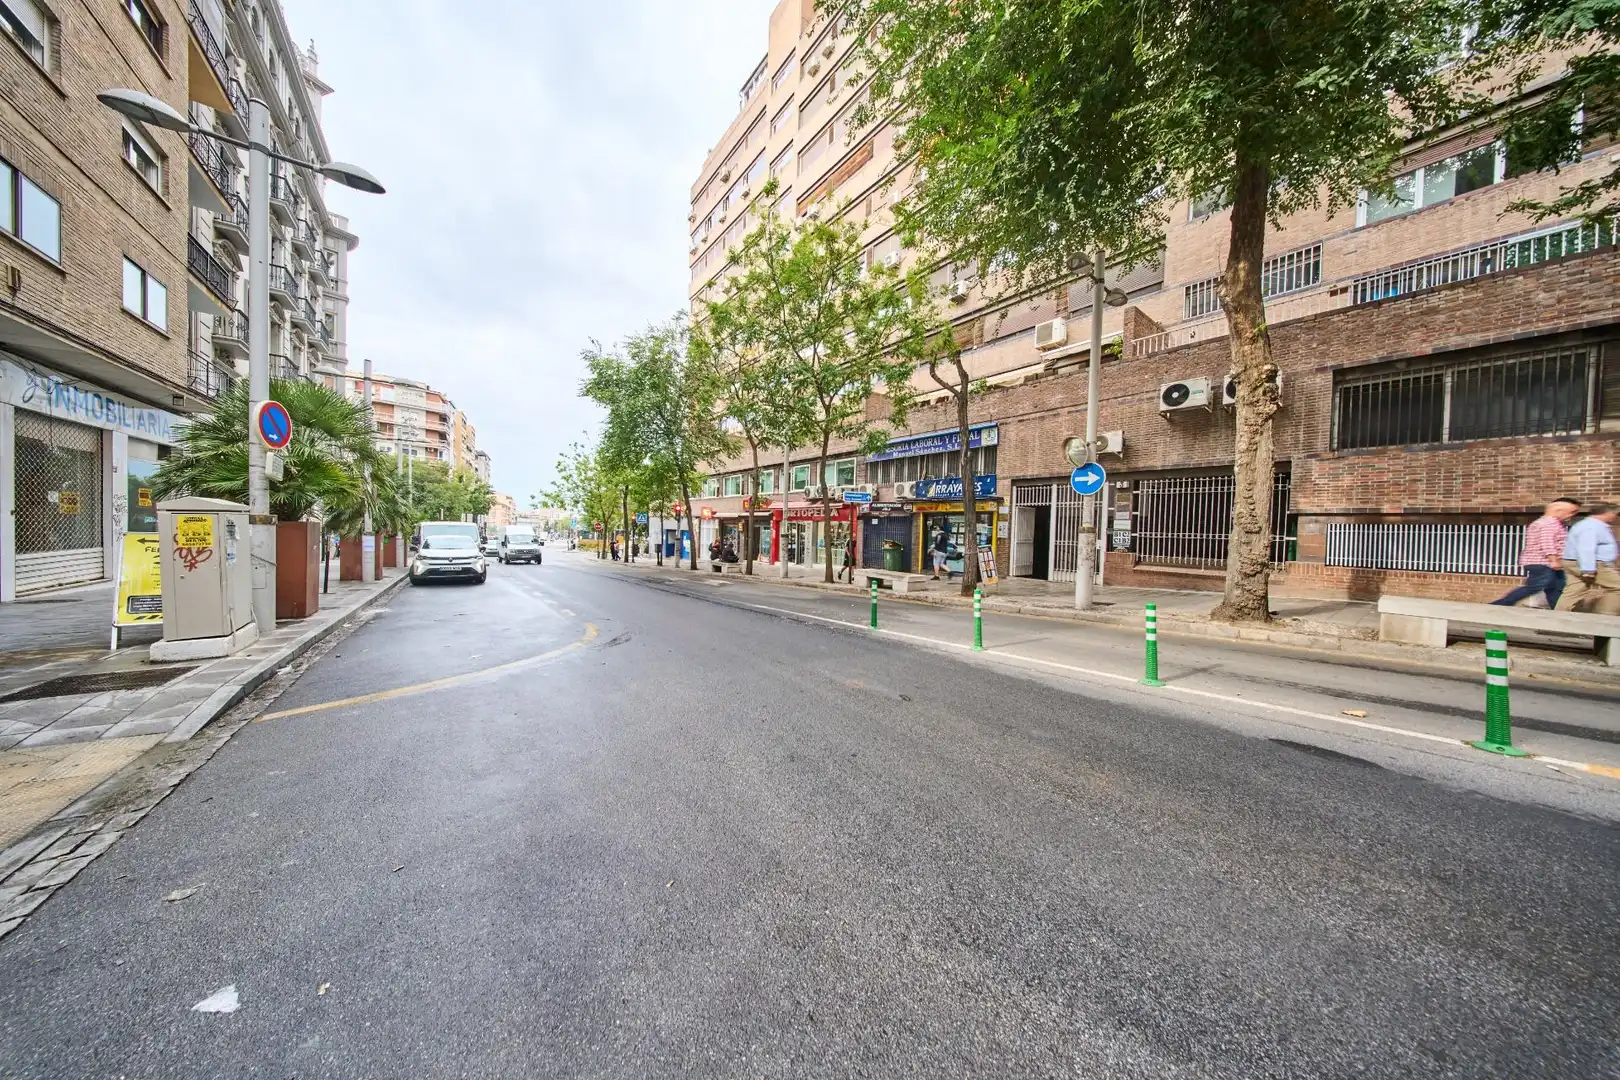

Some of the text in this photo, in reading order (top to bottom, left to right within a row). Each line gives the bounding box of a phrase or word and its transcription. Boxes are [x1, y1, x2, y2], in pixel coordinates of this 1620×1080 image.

[46, 378, 170, 437] INMOBILIARIA
[911, 437, 943, 450] LABORAL
[944, 434, 951, 444] Y
[952, 431, 980, 442] FIAL
[893, 446, 915, 458] Manuel
[927, 481, 982, 497] ARRAYAS
